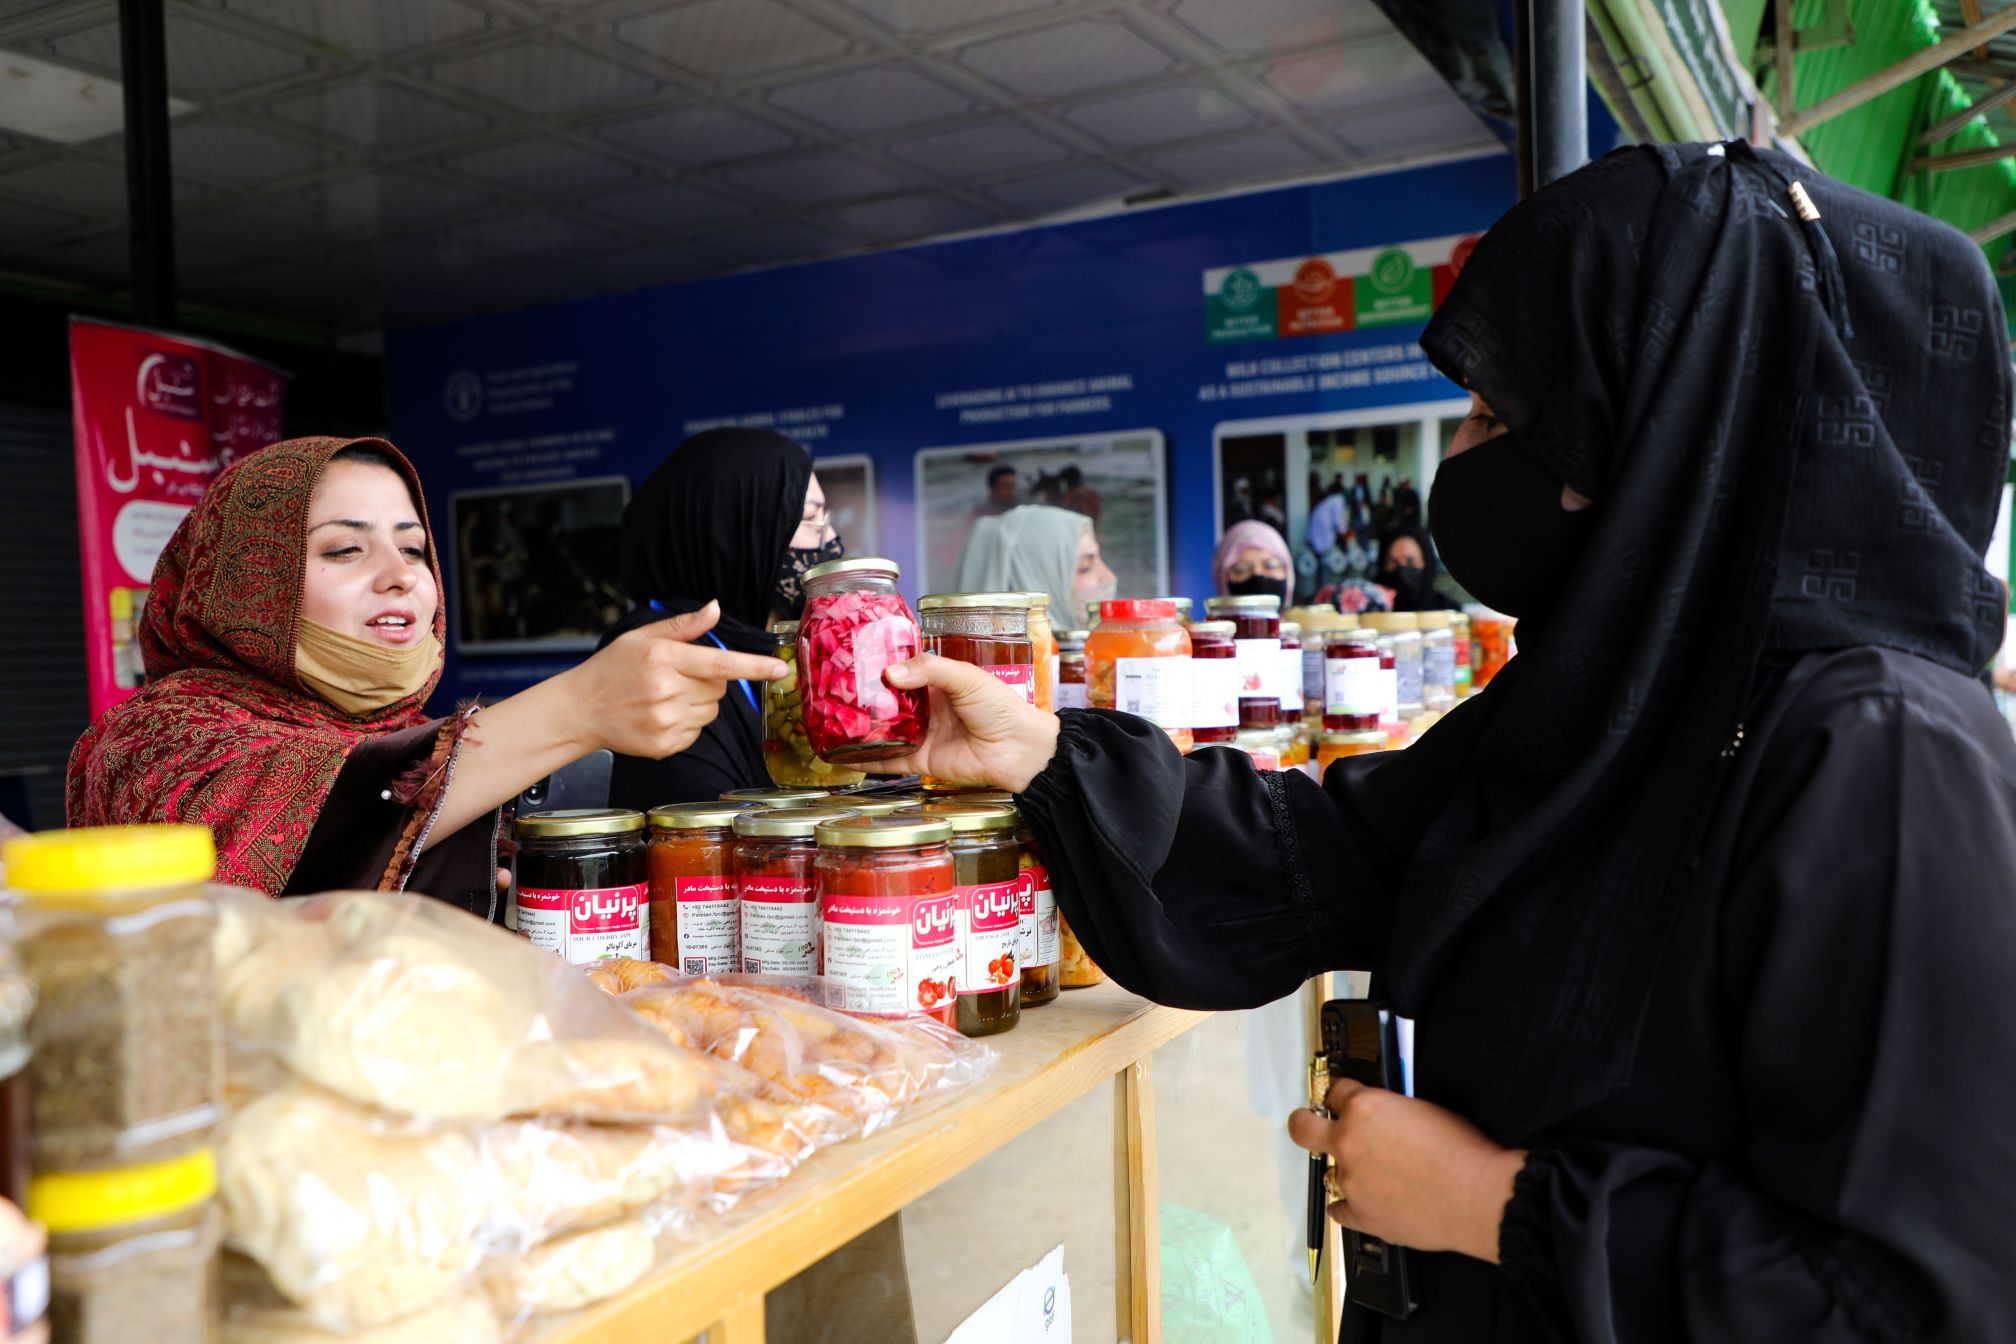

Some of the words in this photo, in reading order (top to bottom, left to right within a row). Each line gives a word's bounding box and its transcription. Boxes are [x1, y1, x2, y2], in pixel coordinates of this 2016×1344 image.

[1259, 352, 1341, 376] COLLECTION
[1317, 369, 1371, 391] INCOME
[683, 884, 697, 893] مادر
[574, 892, 637, 921] پرنیان
